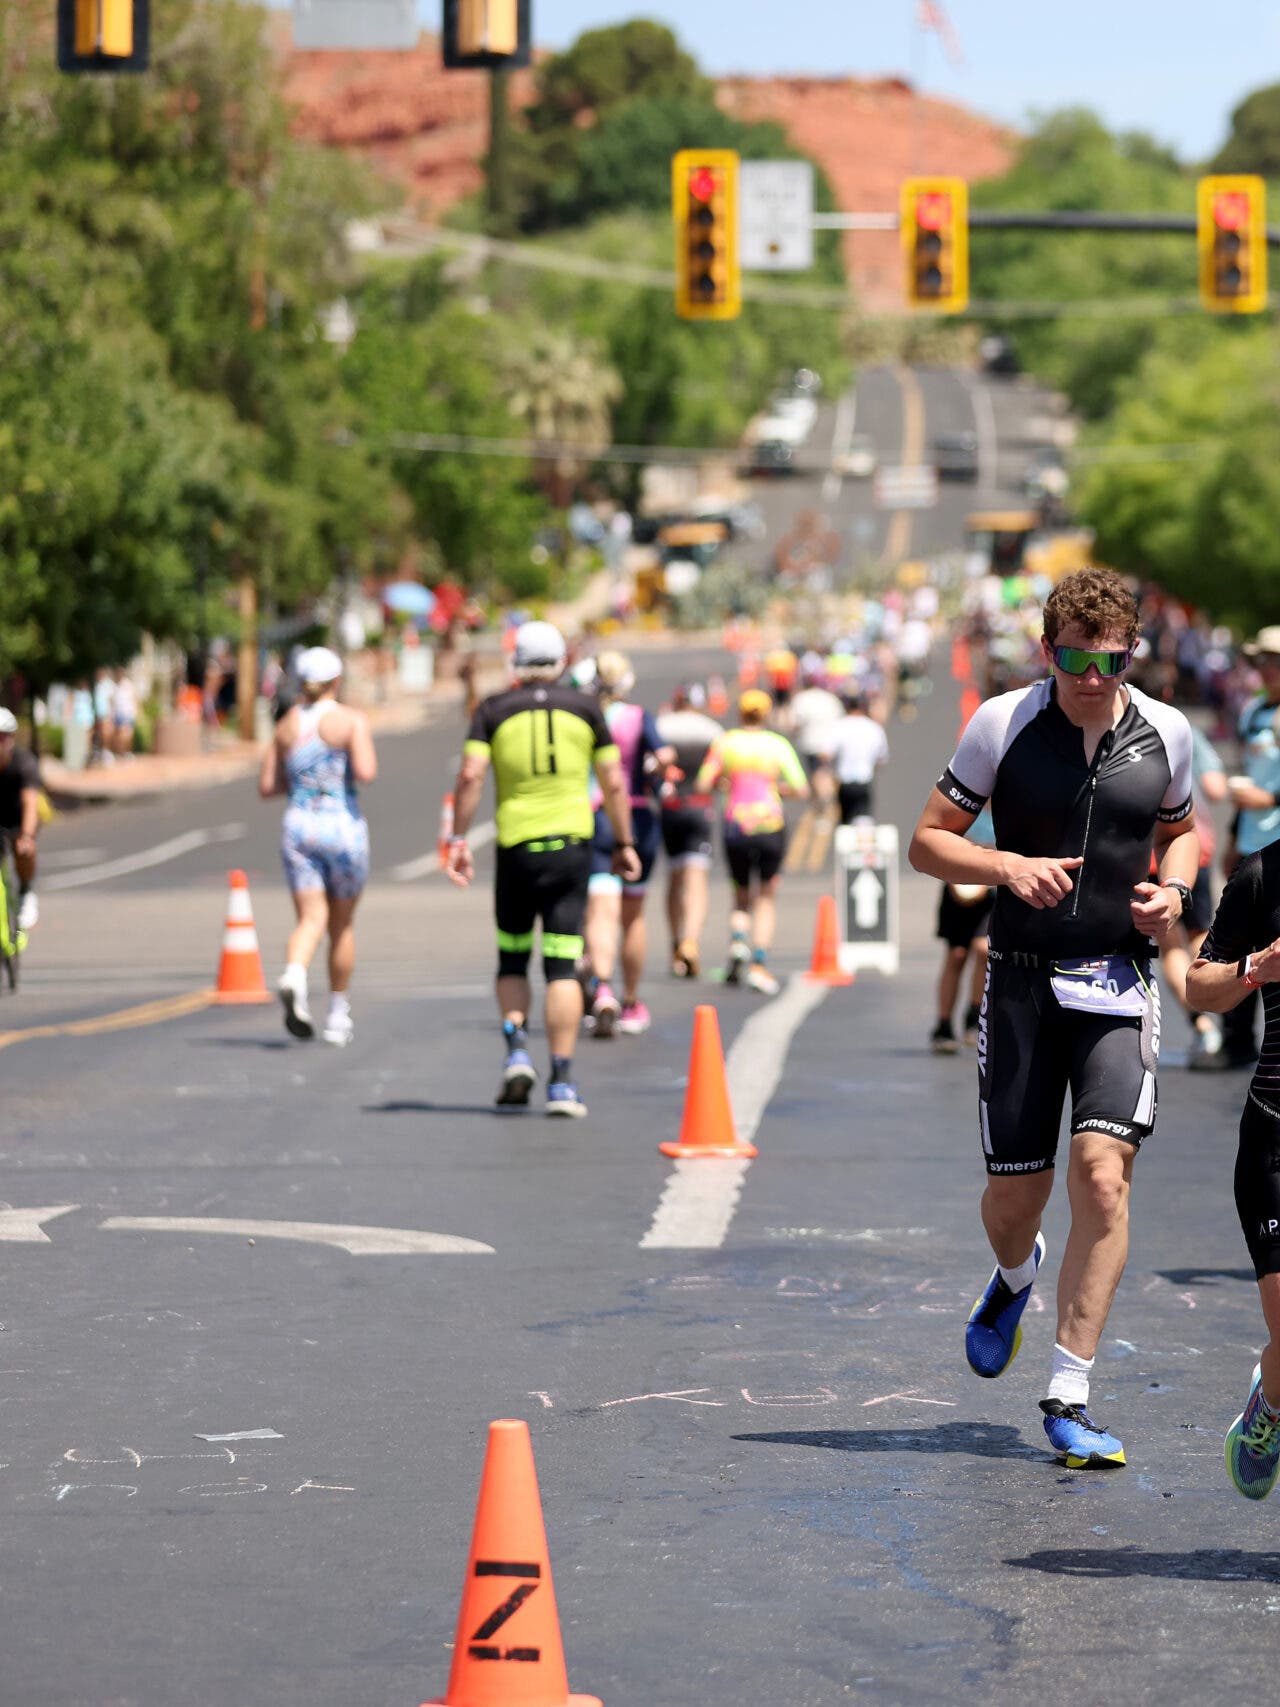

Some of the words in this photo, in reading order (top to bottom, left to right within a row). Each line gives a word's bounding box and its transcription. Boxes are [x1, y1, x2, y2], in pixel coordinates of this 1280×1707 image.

[949, 787, 980, 810] syne
[1157, 802, 1190, 820] ergy
[989, 1157, 1046, 1172] synergy
